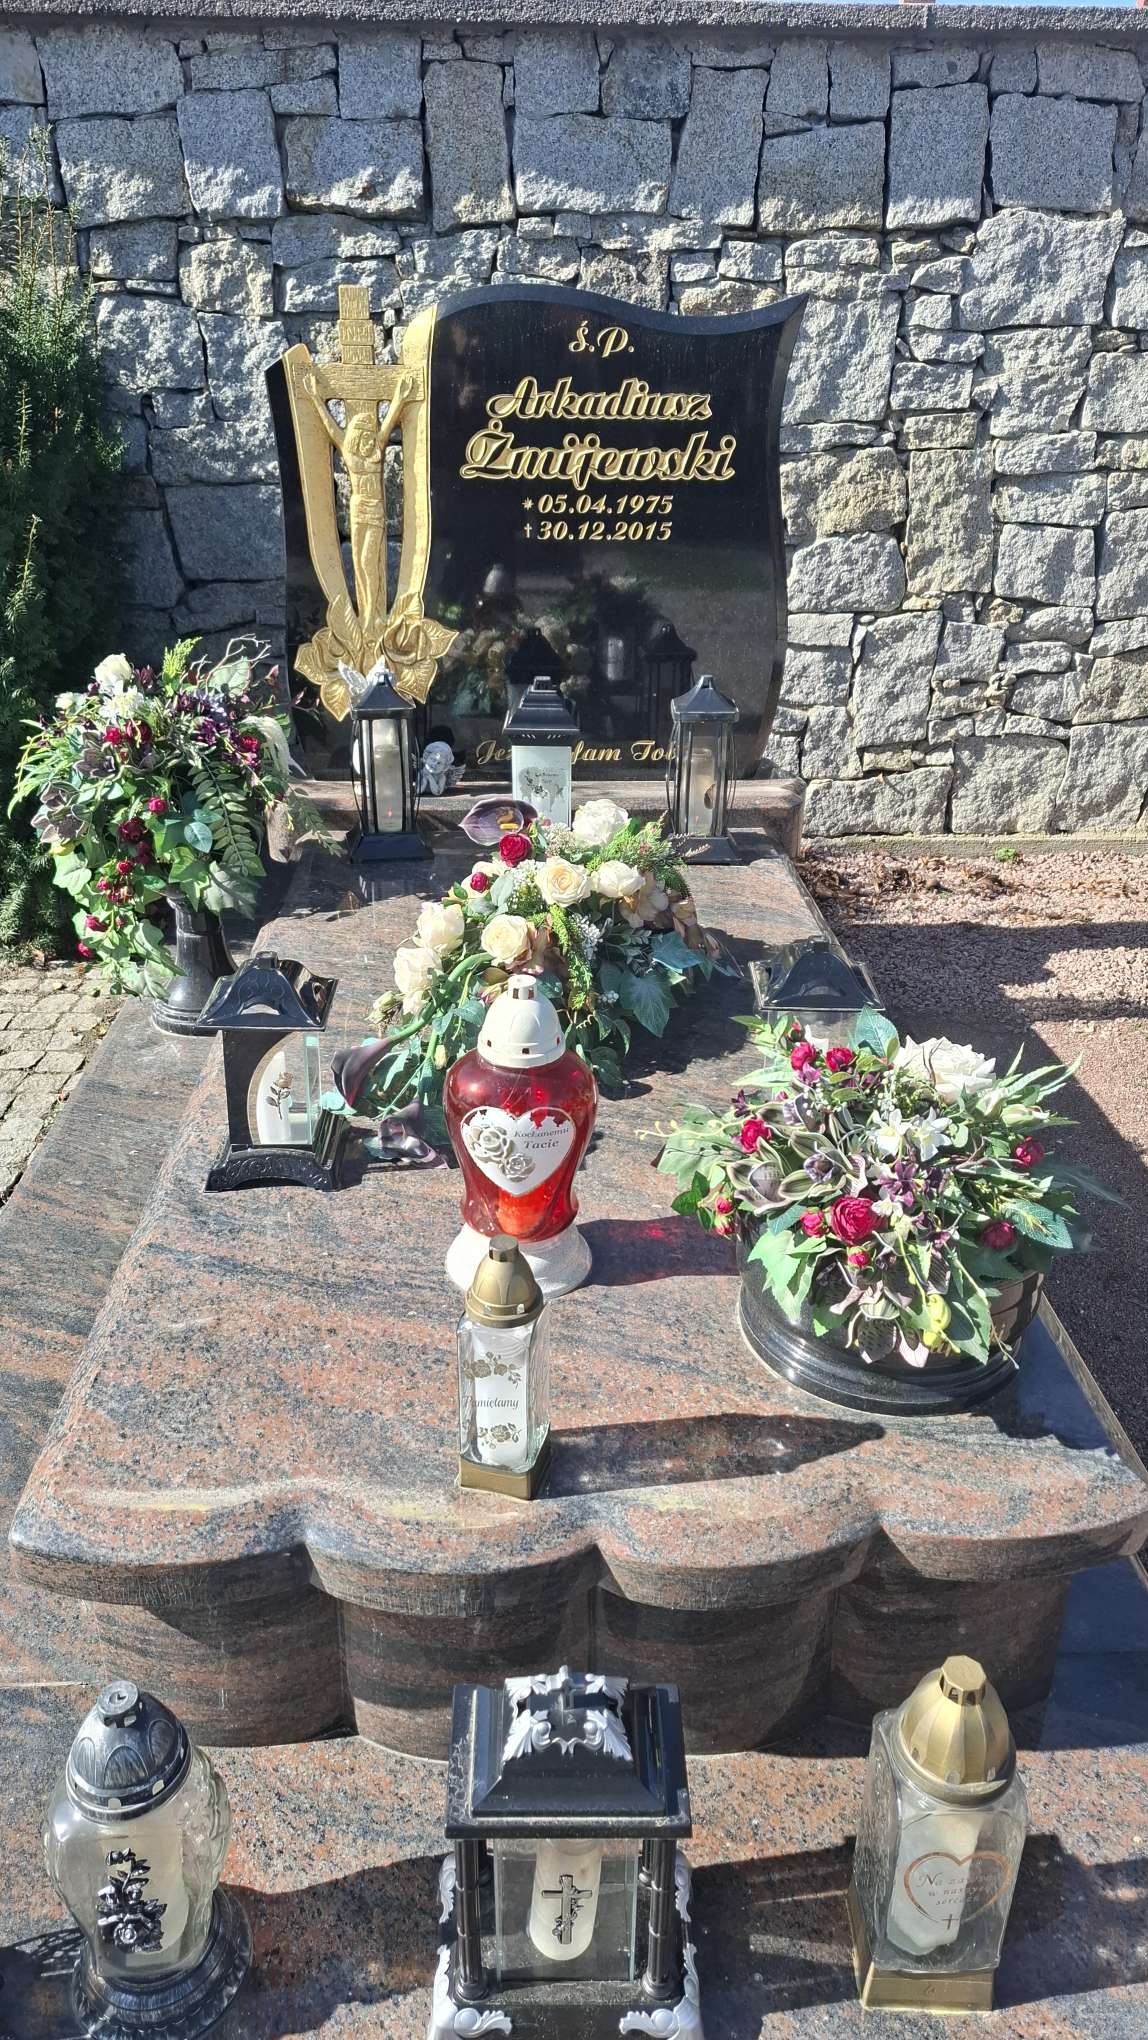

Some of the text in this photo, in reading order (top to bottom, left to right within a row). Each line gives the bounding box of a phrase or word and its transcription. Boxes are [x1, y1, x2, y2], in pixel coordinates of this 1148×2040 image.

[485, 375, 713, 420] Arkadiusz
[459, 418, 737, 491] Żmijewski
[475, 739, 676, 765] Jez fam Tob
